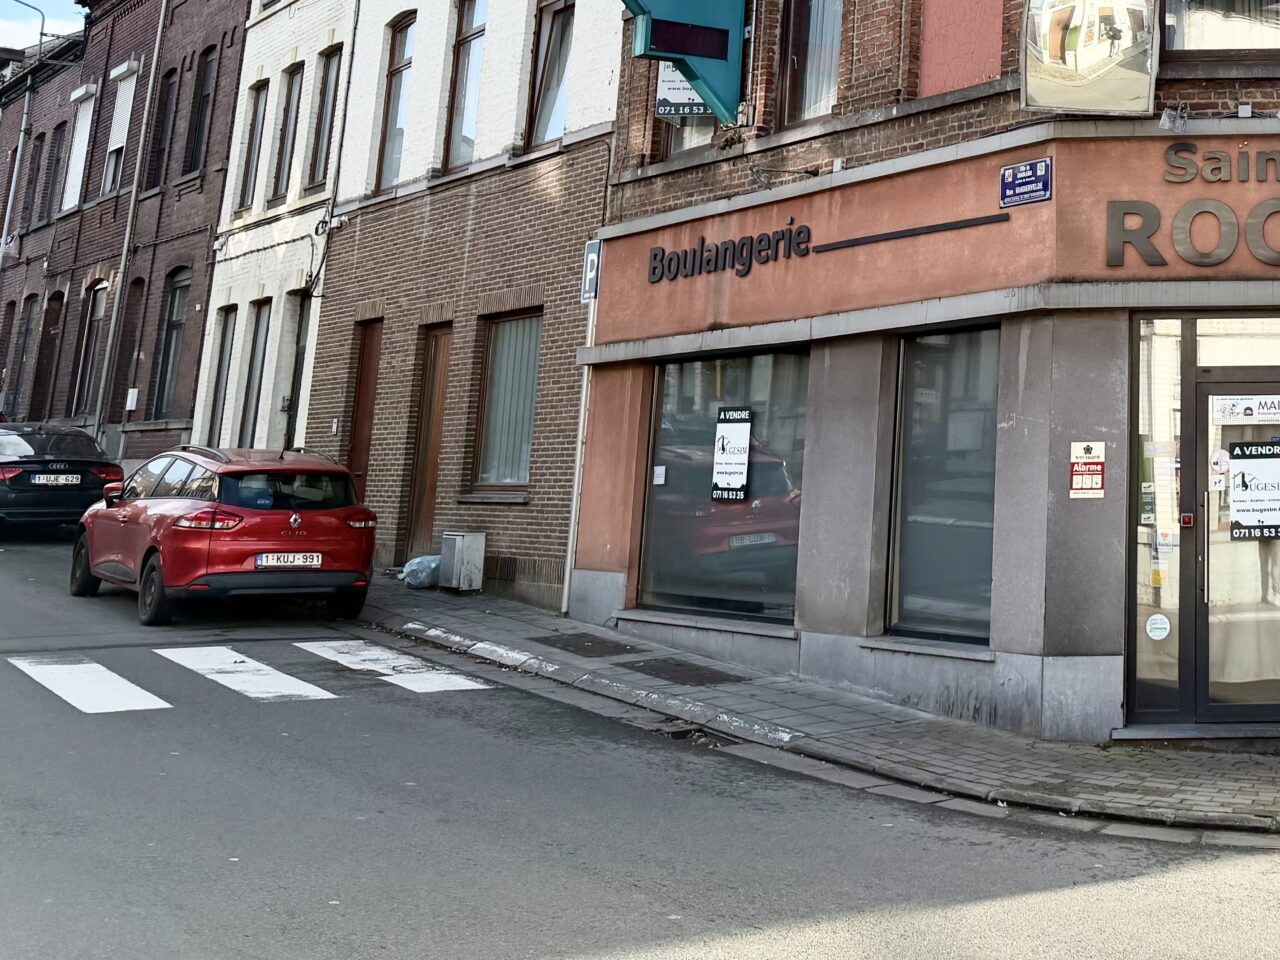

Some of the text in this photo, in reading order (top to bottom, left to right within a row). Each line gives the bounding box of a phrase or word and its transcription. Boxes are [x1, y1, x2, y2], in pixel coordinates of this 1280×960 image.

[658, 106, 676, 114] 071
[678, 106, 690, 114] 16
[692, 106, 705, 114] 53
[647, 215, 812, 284] Boulangerie
[585, 252, 599, 291] P
[719, 410, 750, 420] A VENDRE
[1233, 446, 1242, 456] A
[1072, 462, 1103, 472] Alarme
[1232, 529, 1249, 538] 071
[1250, 528, 1261, 537] 16
[1263, 528, 1276, 537] 53
